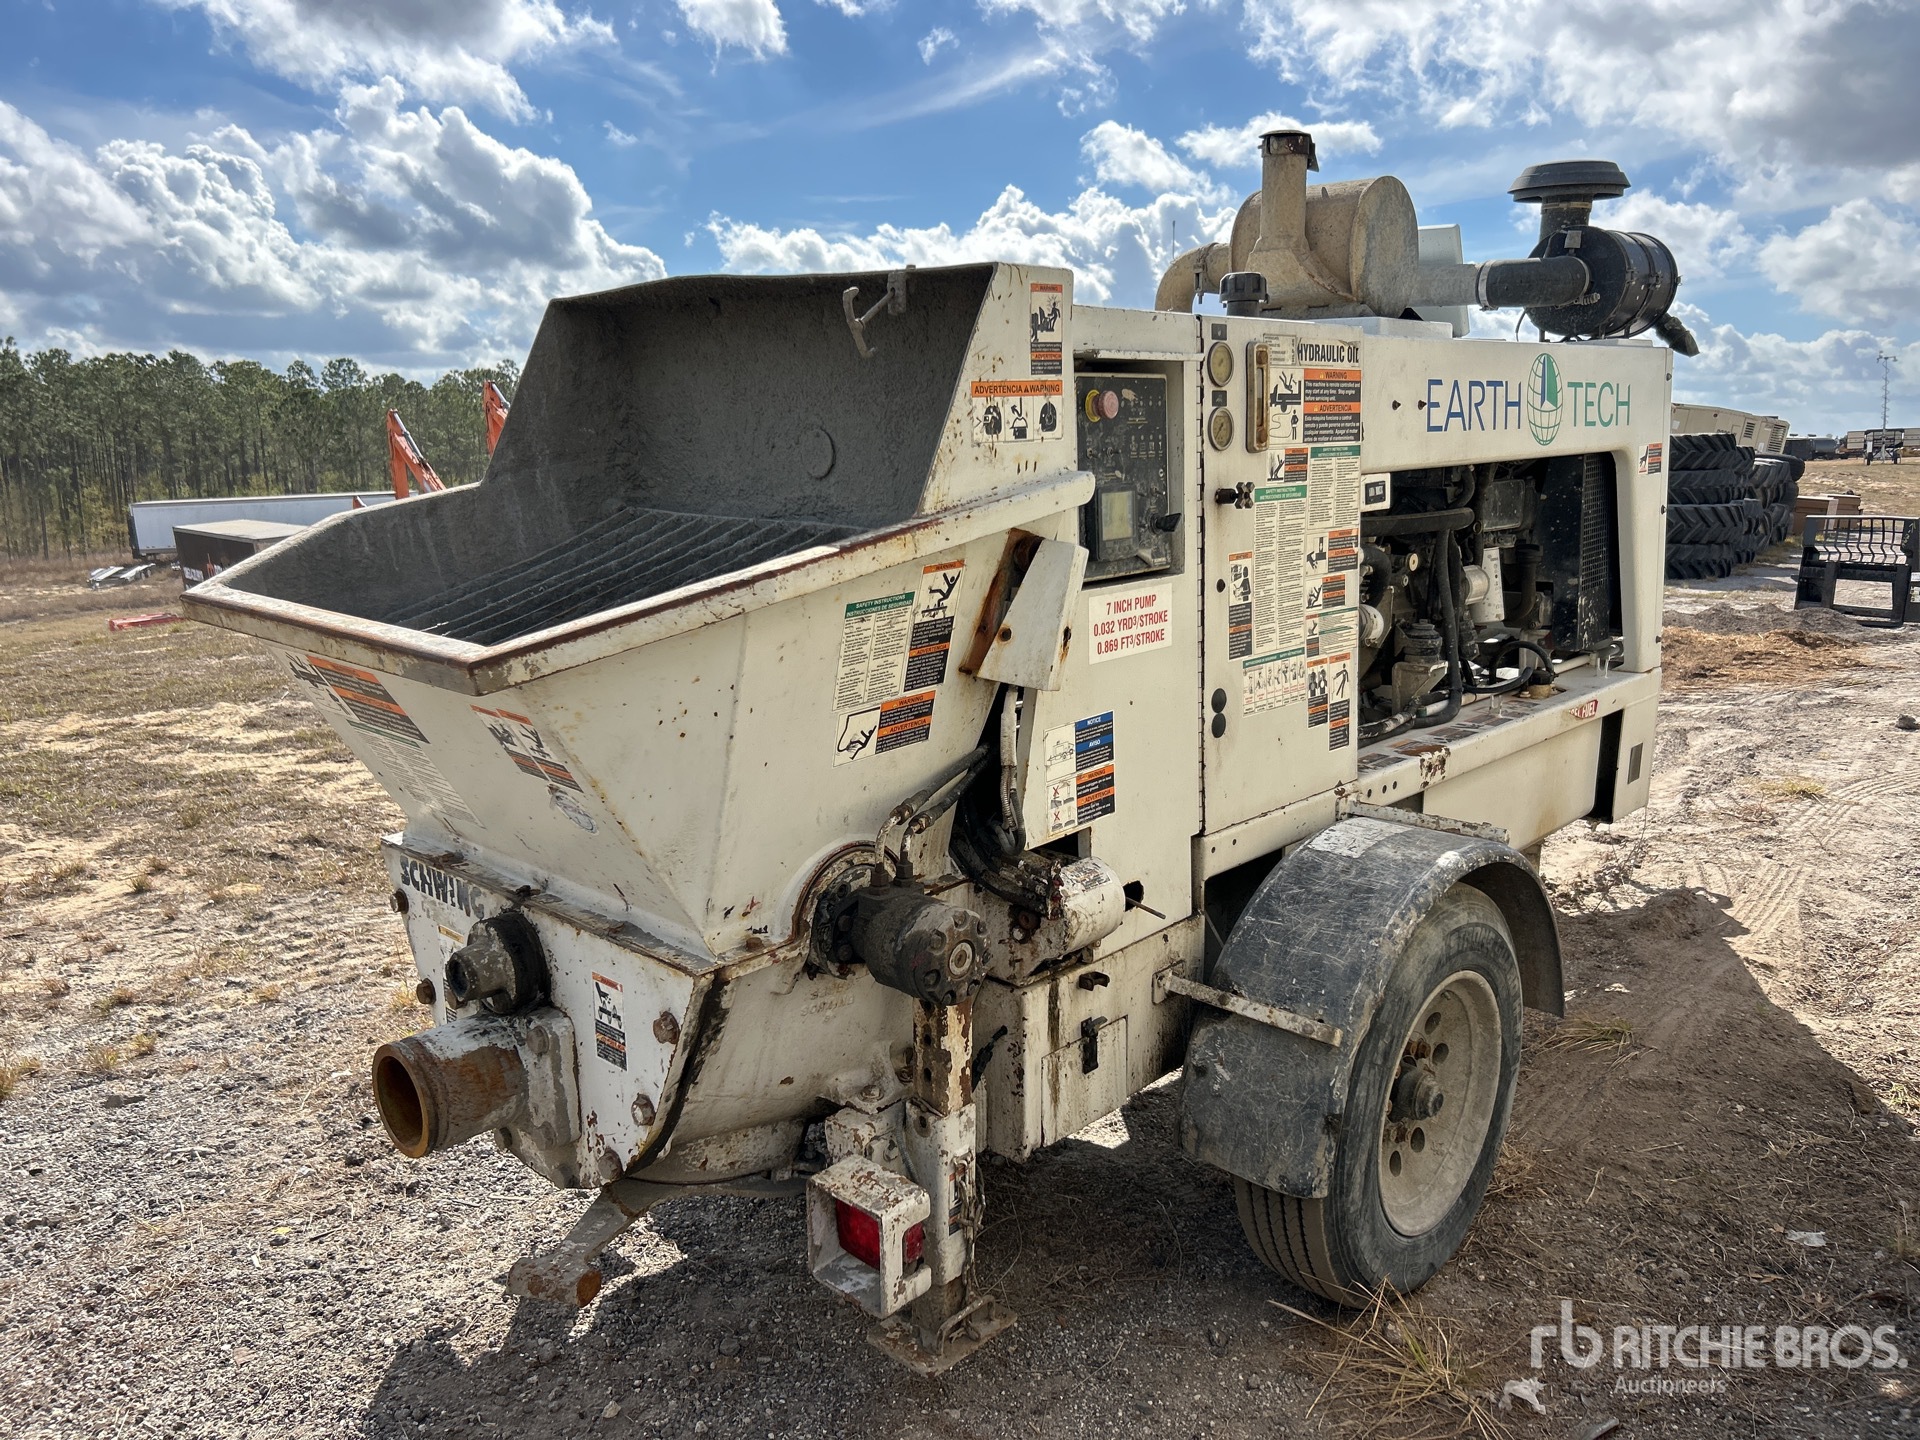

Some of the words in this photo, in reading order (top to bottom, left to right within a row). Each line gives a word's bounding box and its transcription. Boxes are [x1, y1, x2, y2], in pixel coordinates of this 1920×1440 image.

[1297, 344, 1344, 363] HYDRAULIC
[975, 385, 1022, 394] ADVERTENCIA
[1030, 385, 1060, 393] WARNING
[1426, 379, 1521, 432] EARTH
[1567, 382, 1630, 427] TECH
[874, 595, 905, 605] INSTRUCTIONS
[1107, 603, 1111, 615] 7
[1114, 599, 1132, 614] INCH
[1135, 594, 1156, 610] PUMP
[847, 606, 880, 617] INSTRUCCIONES
[888, 600, 912, 608] SEGURIDAD
[1094, 621, 1114, 636] 0.032
[1097, 639, 1118, 654] 0.869
[899, 696, 923, 705] WARNING
[890, 719, 926, 733] ADVERTENCIA
[1087, 716, 1101, 725] NOTICE
[1088, 769, 1105, 778] WARNING
[1085, 790, 1110, 802] ADVERTENCIA
